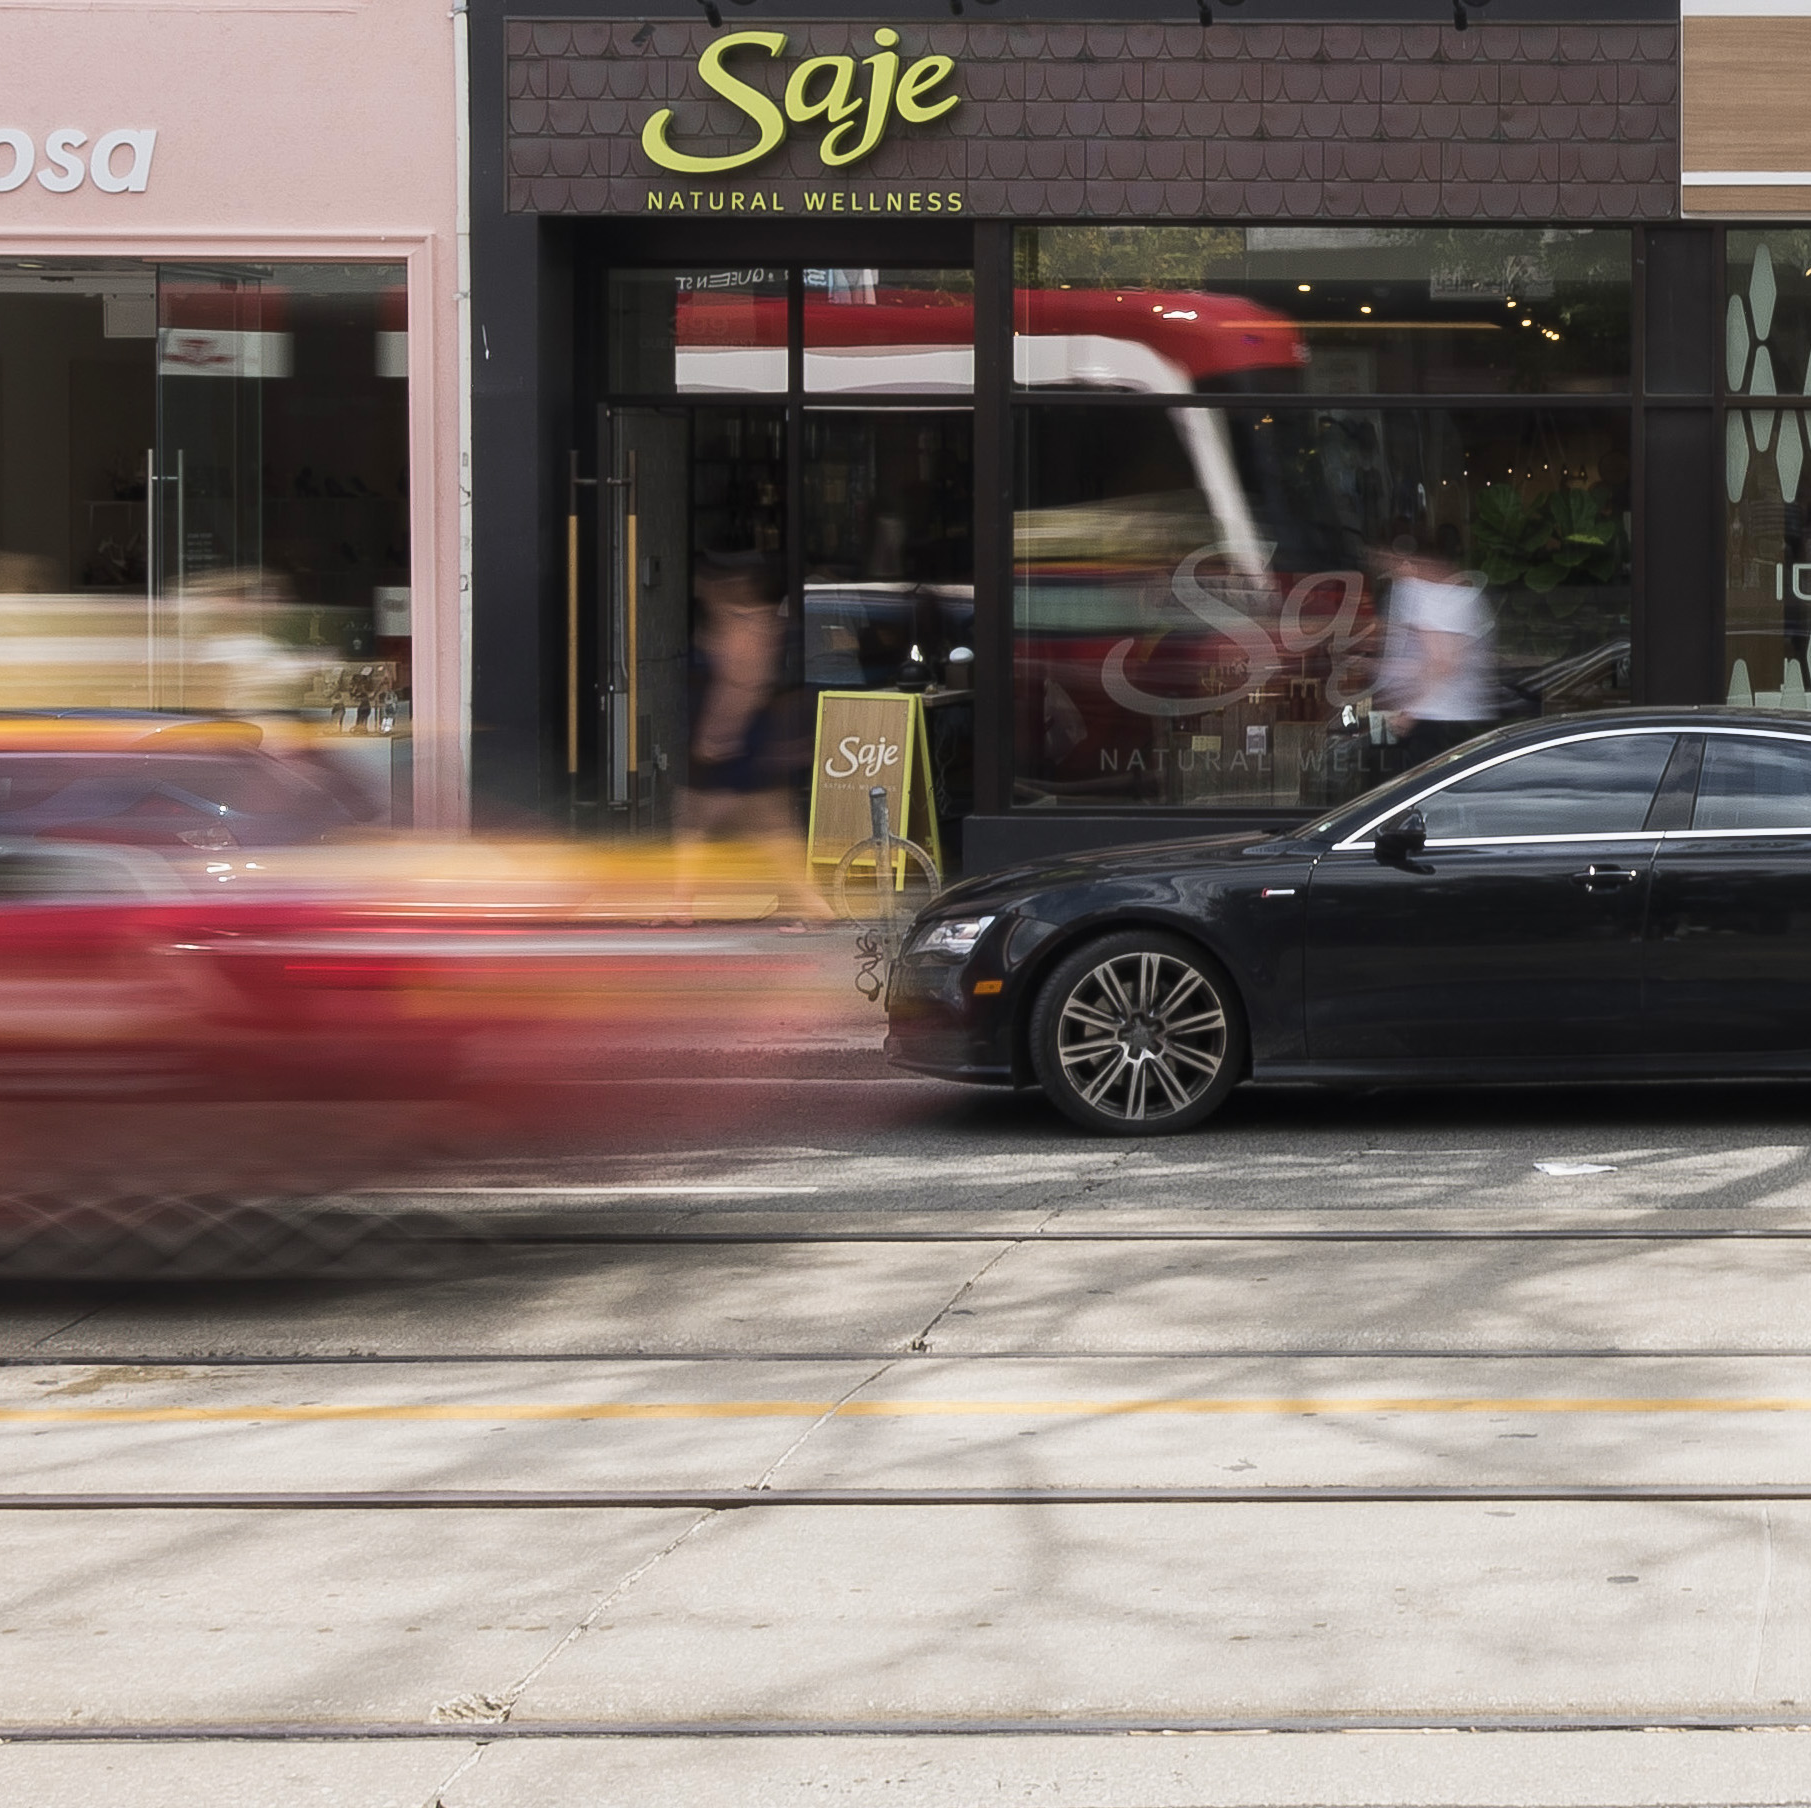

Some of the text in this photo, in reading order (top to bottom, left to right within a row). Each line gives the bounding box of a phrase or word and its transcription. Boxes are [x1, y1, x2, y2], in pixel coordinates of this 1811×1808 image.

[641, 27, 959, 173] Saje
[647, 191, 962, 212] NATURAL WELLNESS
[825, 736, 899, 778] Saje
[1099, 747, 1272, 772] NATURAL
